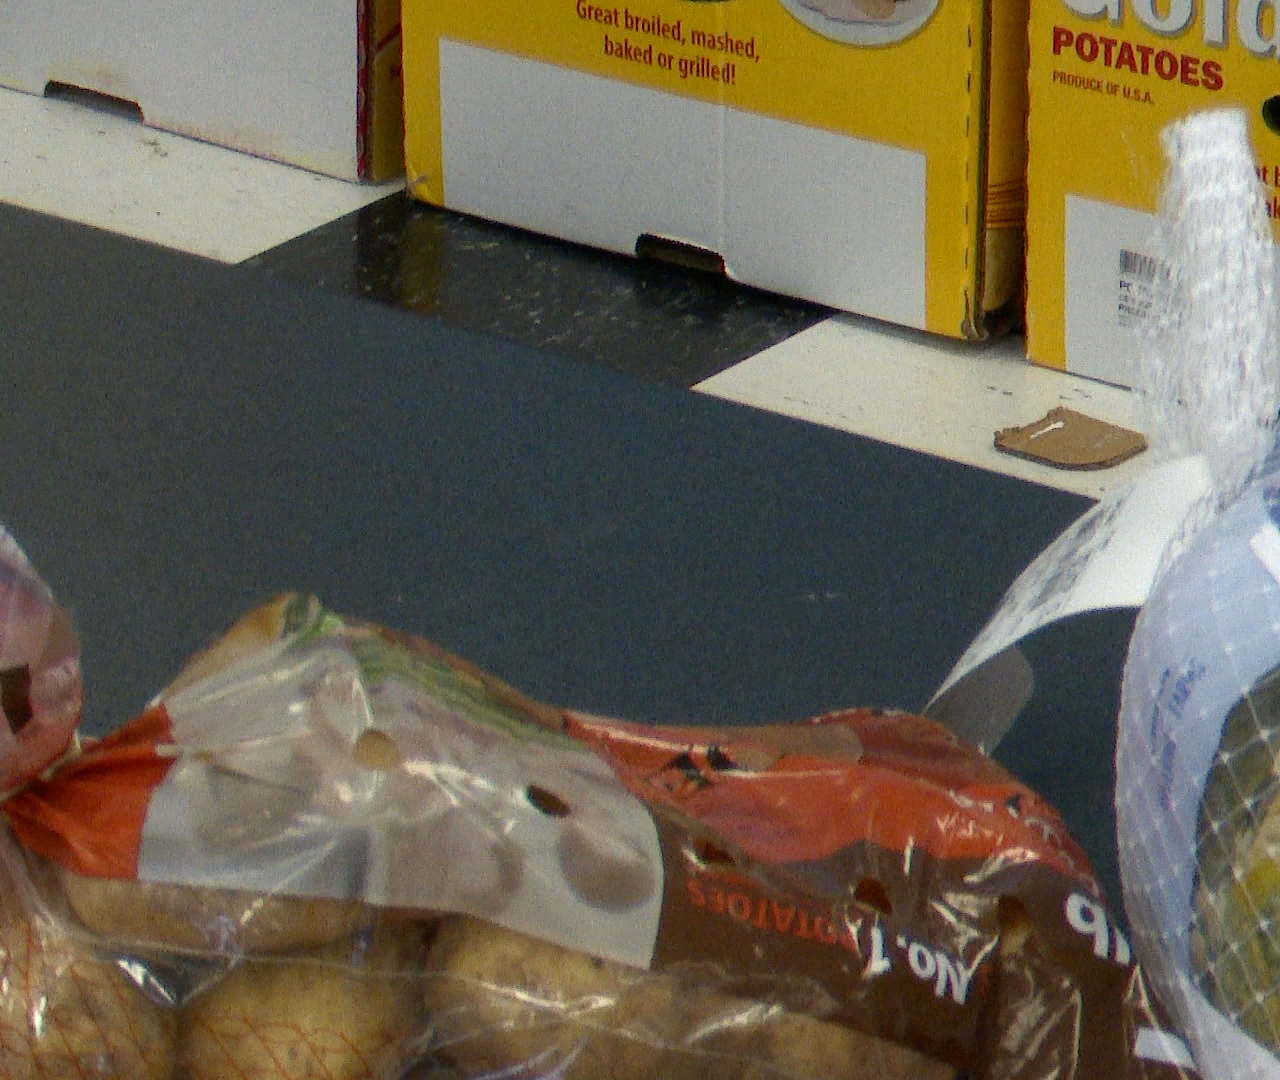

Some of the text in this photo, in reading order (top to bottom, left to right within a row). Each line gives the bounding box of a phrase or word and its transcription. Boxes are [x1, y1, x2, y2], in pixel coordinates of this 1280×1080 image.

[577, 0, 759, 63] Great broiled, mashed,
[604, 34, 735, 85] baked or grilled!
[1052, 25, 1224, 90] POTATOES
[1052, 71, 1154, 104] PRODUCE OF U.S.A.
